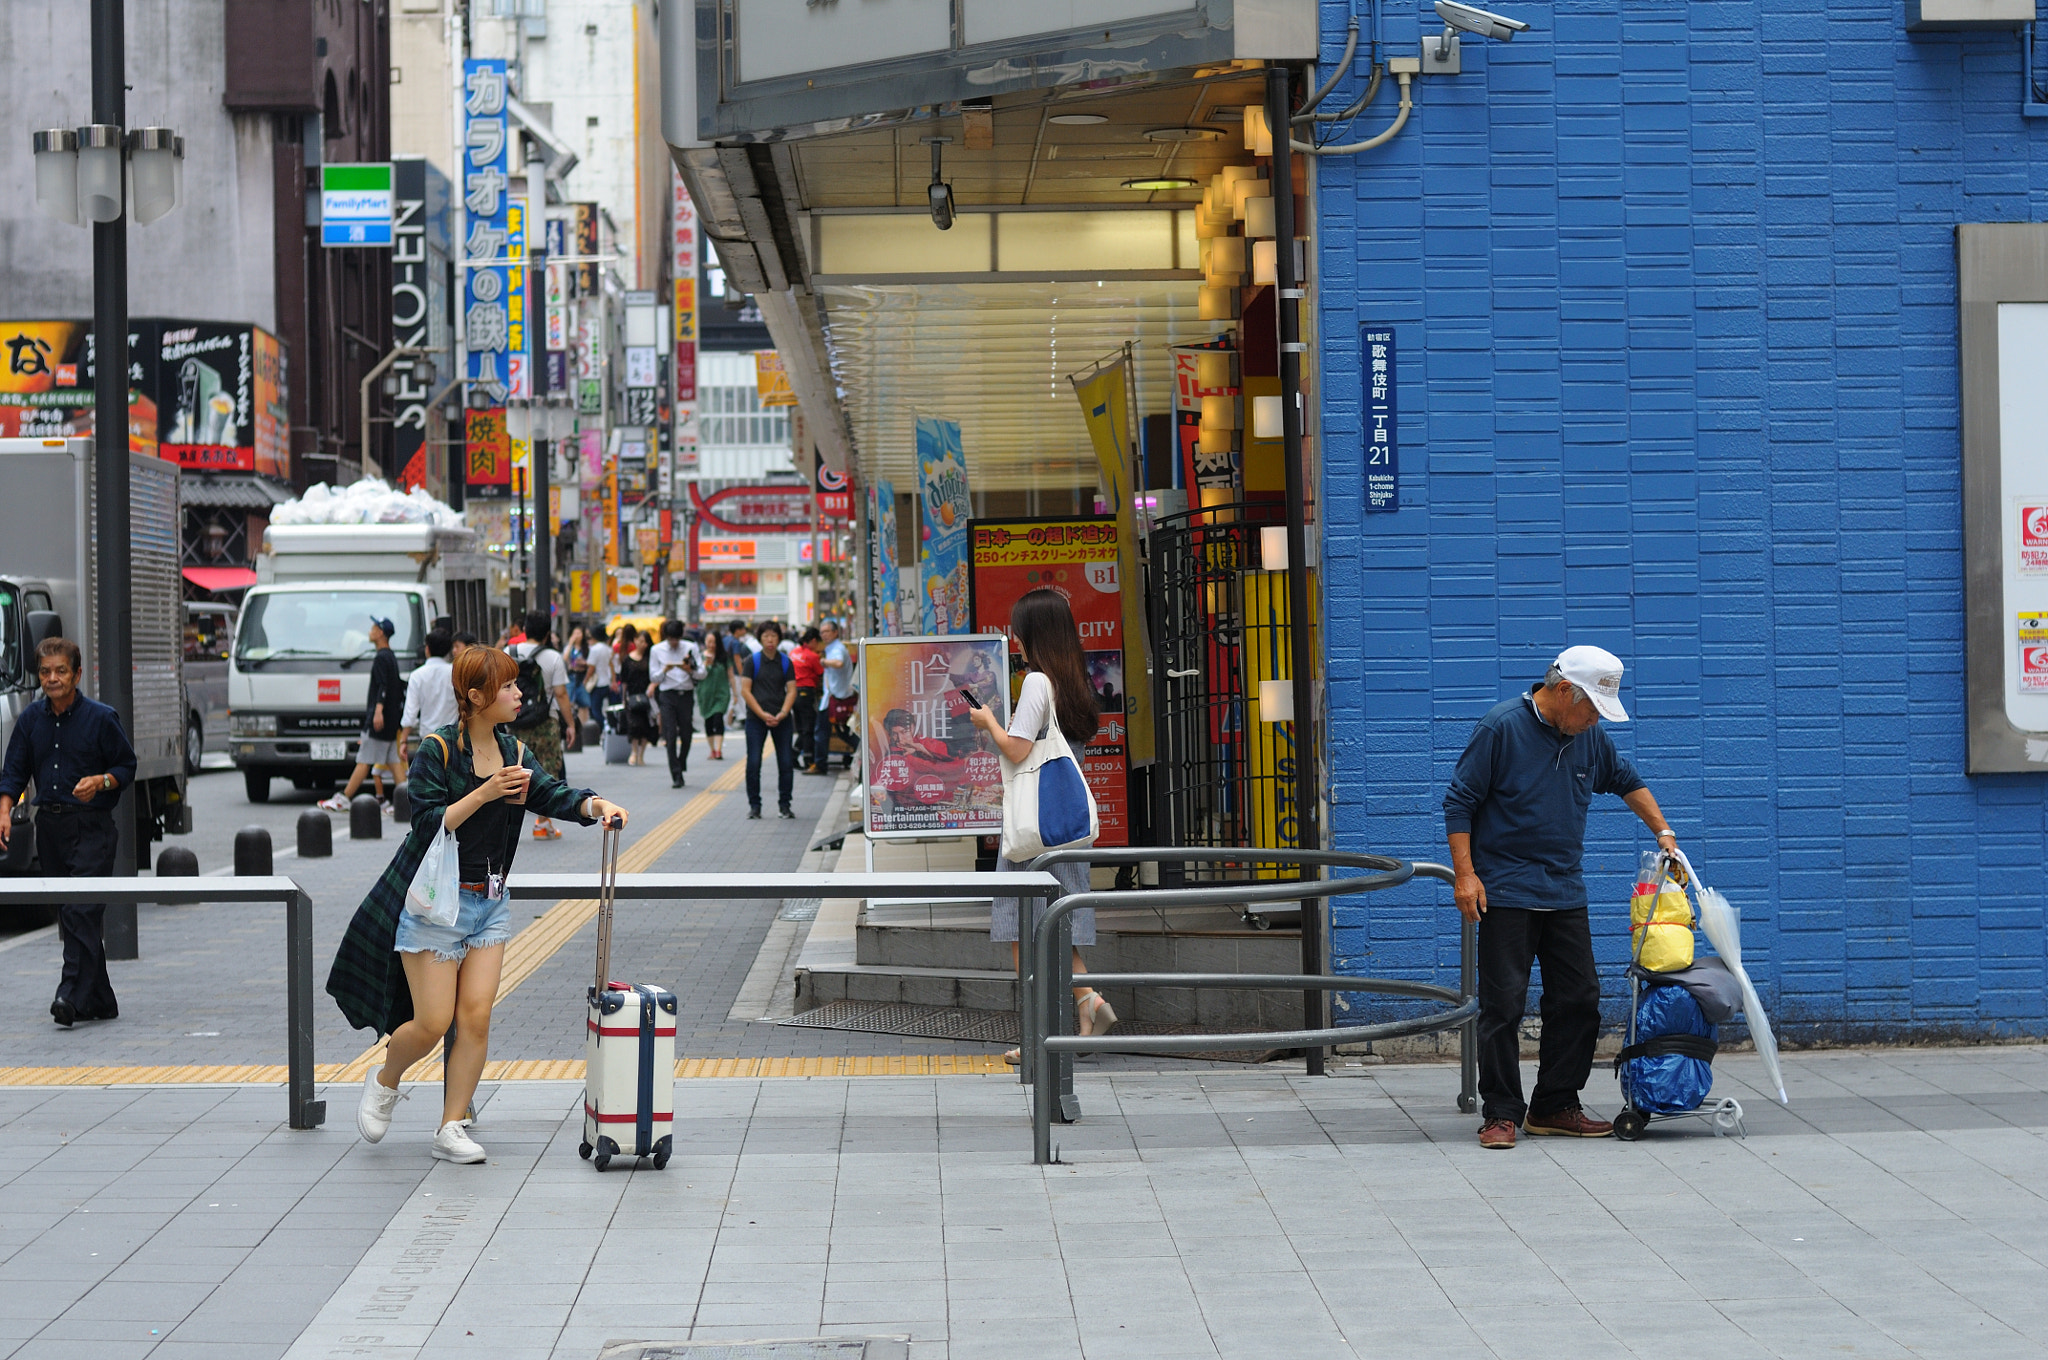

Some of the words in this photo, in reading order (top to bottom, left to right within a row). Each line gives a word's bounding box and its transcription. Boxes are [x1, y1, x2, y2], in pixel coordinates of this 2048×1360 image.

[325, 197, 388, 211] FamilyMart
[675, 172, 692, 267] 好み焼き
[466, 66, 508, 403] カラオケの鉄人
[1371, 344, 1389, 442] 歌舞伎町一丁目
[469, 414, 497, 477] 焼肉
[1369, 446, 1389, 465] 21
[1368, 474, 1394, 482] Kabukicho
[1371, 498, 1386, 507] City
[975, 525, 1117, 548] 日本一の超ド迫力
[975, 547, 1117, 563] 250インチスクリーンカラオケ
[1094, 565, 1117, 584] B1
[1078, 620, 1116, 638] CITY
[299, 719, 360, 727] CANTER
[1085, 747, 1102, 756] orld
[871, 813, 938, 823] Entertainment
[940, 811, 967, 821] Show
[968, 811, 976, 820] &
[978, 809, 1003, 820] Buffe
